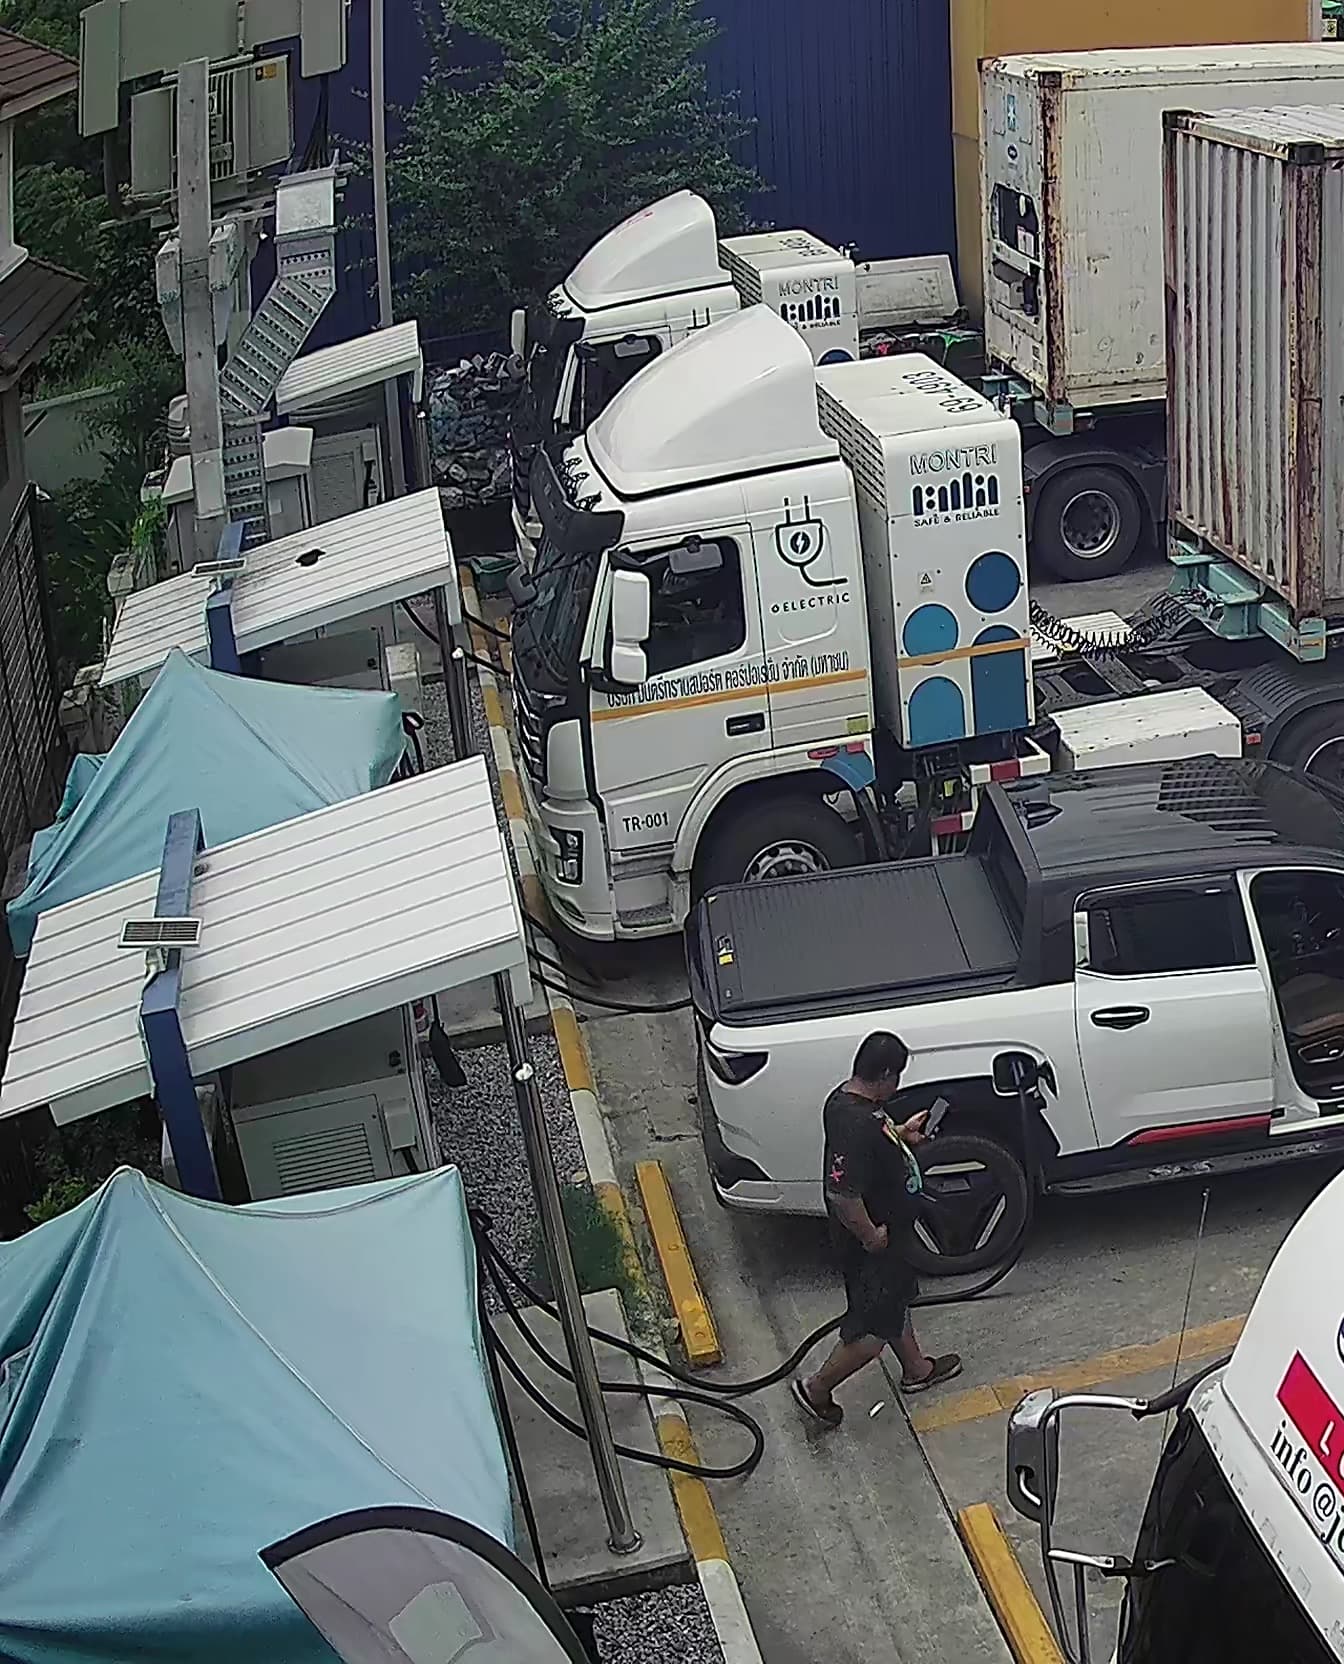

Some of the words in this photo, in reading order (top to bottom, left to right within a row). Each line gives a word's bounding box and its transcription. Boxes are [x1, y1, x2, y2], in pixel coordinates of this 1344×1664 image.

[779, 275, 839, 297] MONTRI
[902, 370, 984, 414] 69-4903
[909, 444, 998, 476] MONTRI
[914, 512, 940, 528] SAFE
[944, 515, 951, 523] &
[955, 507, 1000, 523] RELIABLE
[782, 654, 809, 681] จำกัด
[811, 649, 850, 678] (มหาชน)
[622, 811, 669, 833] TR-001
